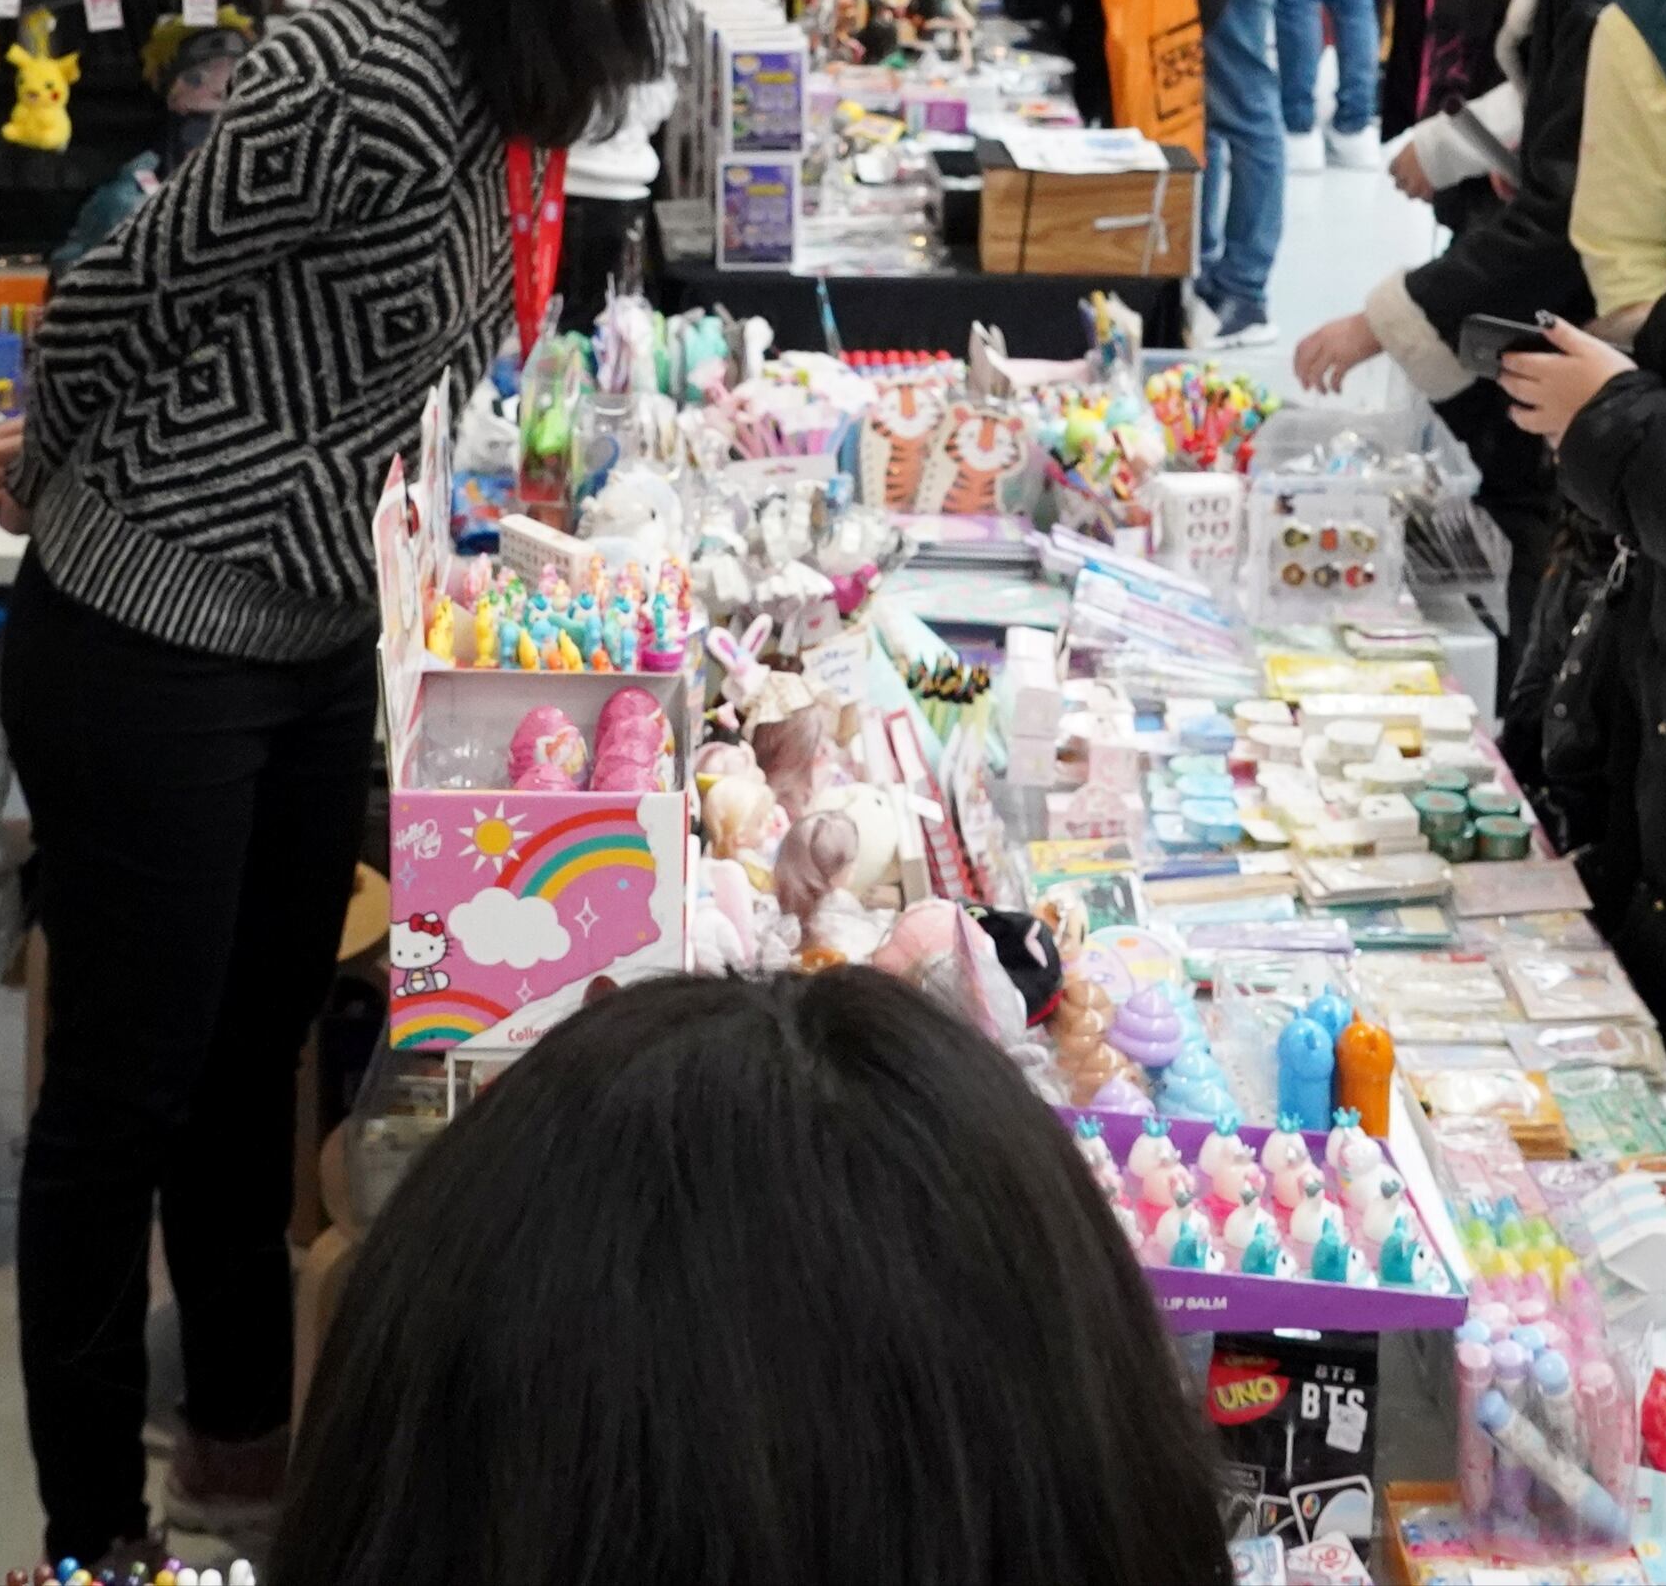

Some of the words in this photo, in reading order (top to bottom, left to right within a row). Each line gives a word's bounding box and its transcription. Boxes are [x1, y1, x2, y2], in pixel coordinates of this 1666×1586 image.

[1163, 1296, 1184, 1311] LIP
[1185, 1295, 1228, 1311] BALM
[1314, 1363, 1357, 1384] BTS
[1214, 1375, 1279, 1411] UNO
[1300, 1381, 1367, 1420] BTS
